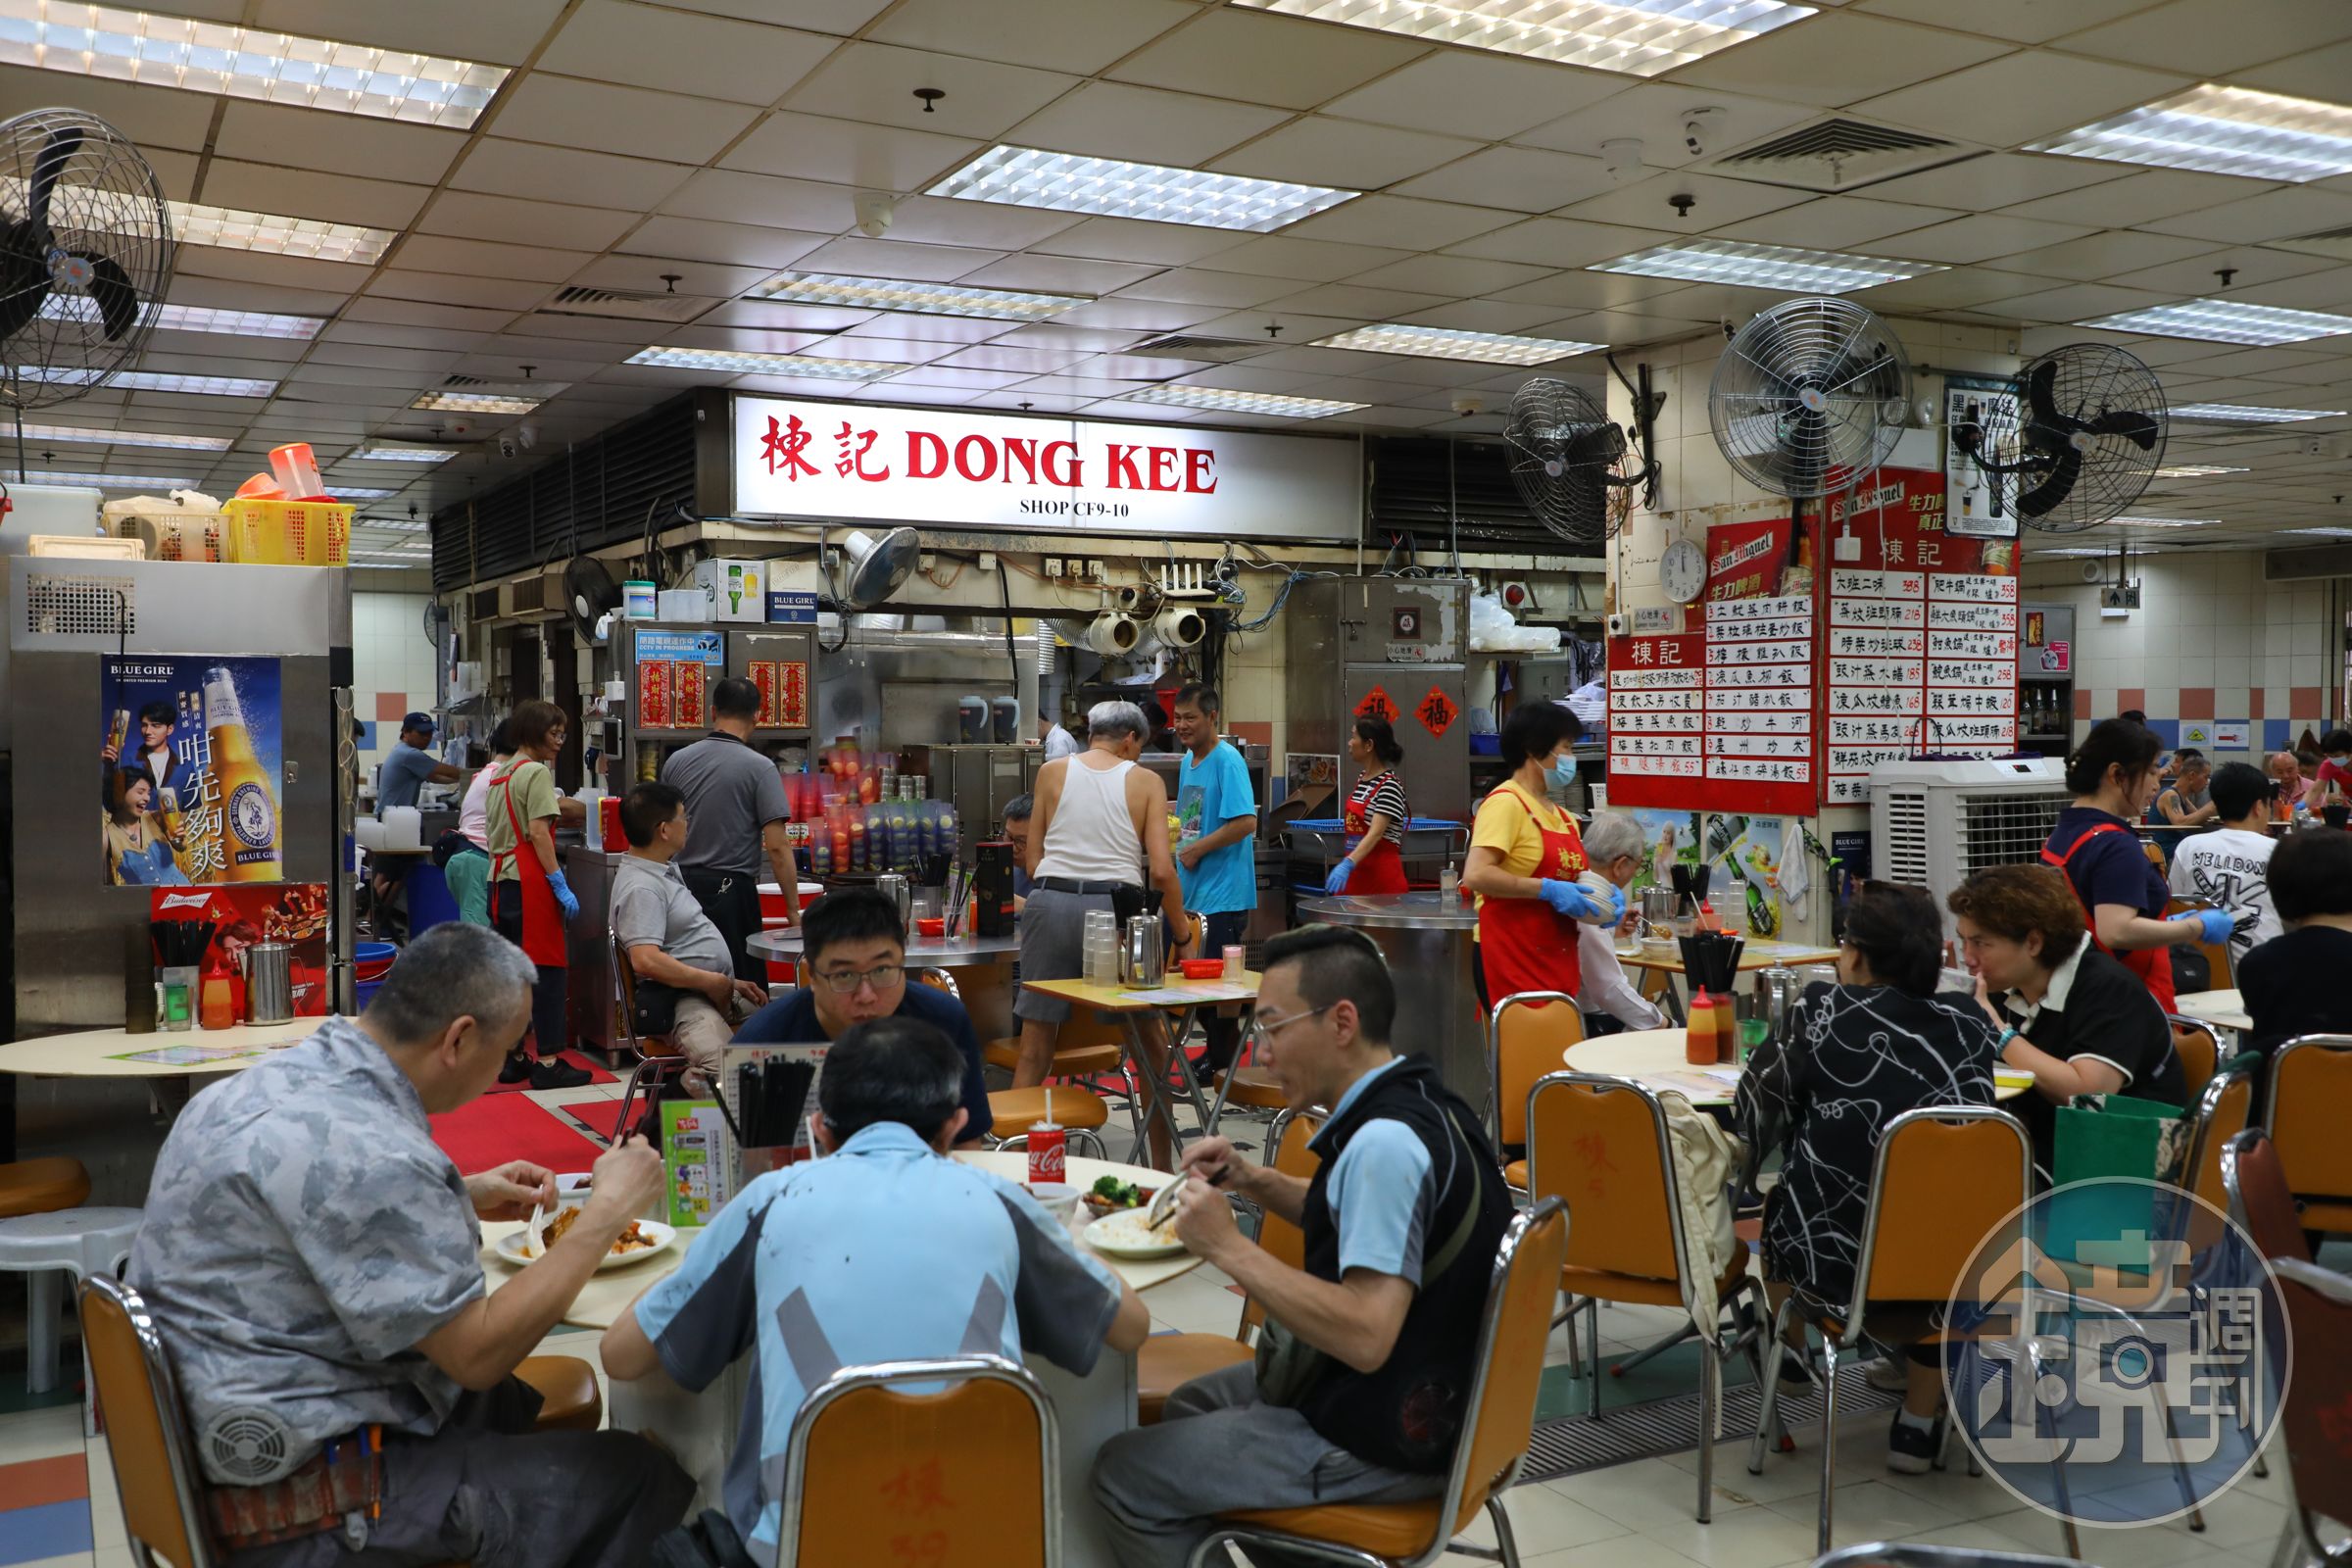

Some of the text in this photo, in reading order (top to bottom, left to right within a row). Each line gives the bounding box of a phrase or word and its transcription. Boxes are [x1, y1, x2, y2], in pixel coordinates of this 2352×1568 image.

[760, 414, 890, 482] 棟記
[906, 430, 1218, 494] DONG KEE
[1020, 498, 1130, 518] SHOP CF9-10
[1880, 538, 1942, 565] 棟記
[1904, 609, 1921, 620] 218
[1632, 640, 1683, 665] 棟記
[111, 665, 173, 675] BLUE GIRL
[1423, 697, 1448, 728] 福
[1796, 767, 1807, 780] 55
[1835, 782, 1871, 799] 梅菜
[177, 731, 227, 879] 咁先夠爽
[238, 852, 262, 861] BLUE
[165, 896, 207, 906] Budweiser
